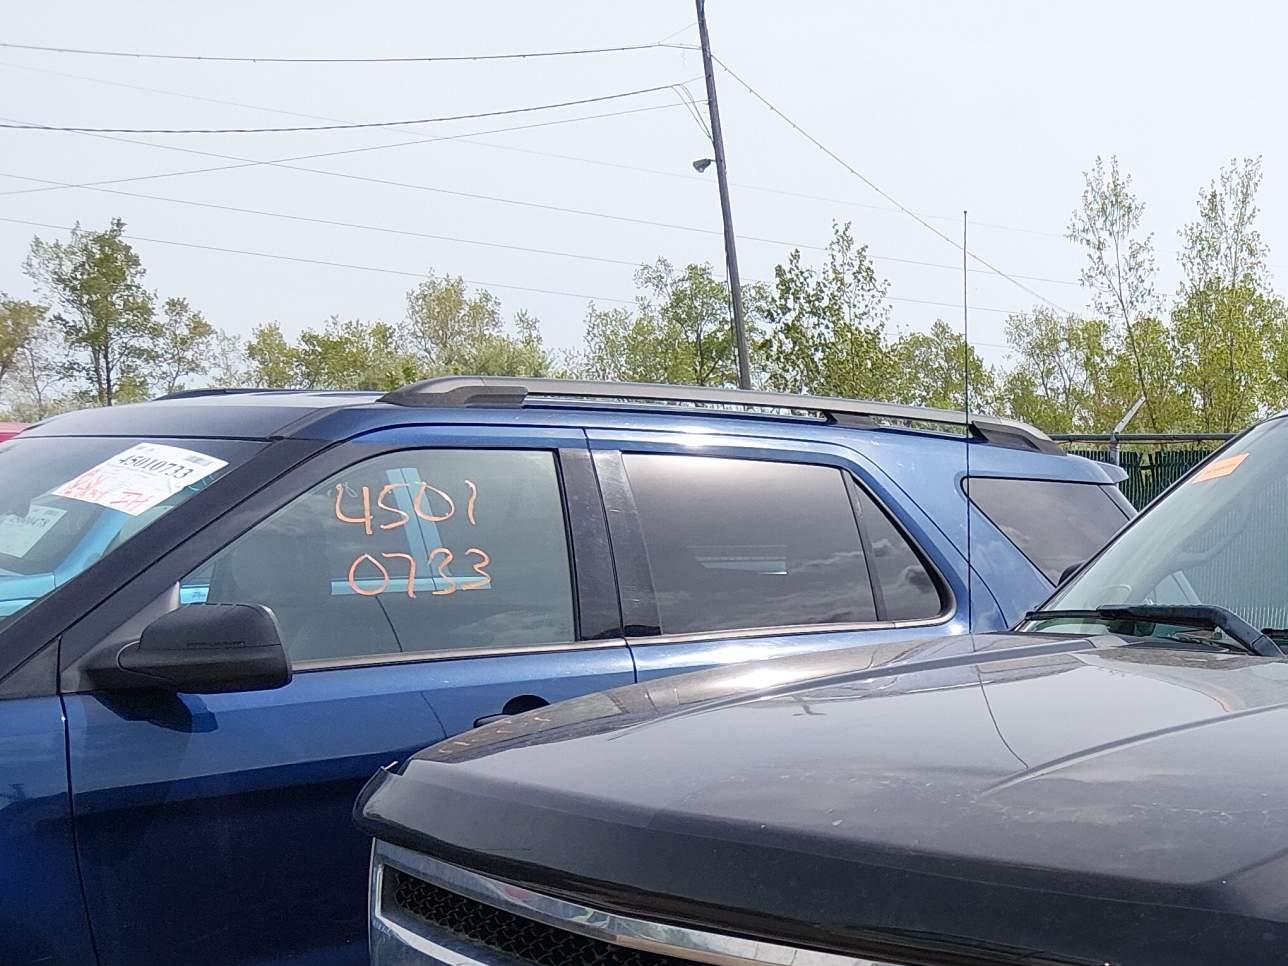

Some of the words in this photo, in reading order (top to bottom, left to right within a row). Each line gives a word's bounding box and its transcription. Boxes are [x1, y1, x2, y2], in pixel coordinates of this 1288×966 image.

[118, 453, 195, 481] 45010733
[335, 479, 477, 535] 4501
[348, 546, 493, 600] 0733
